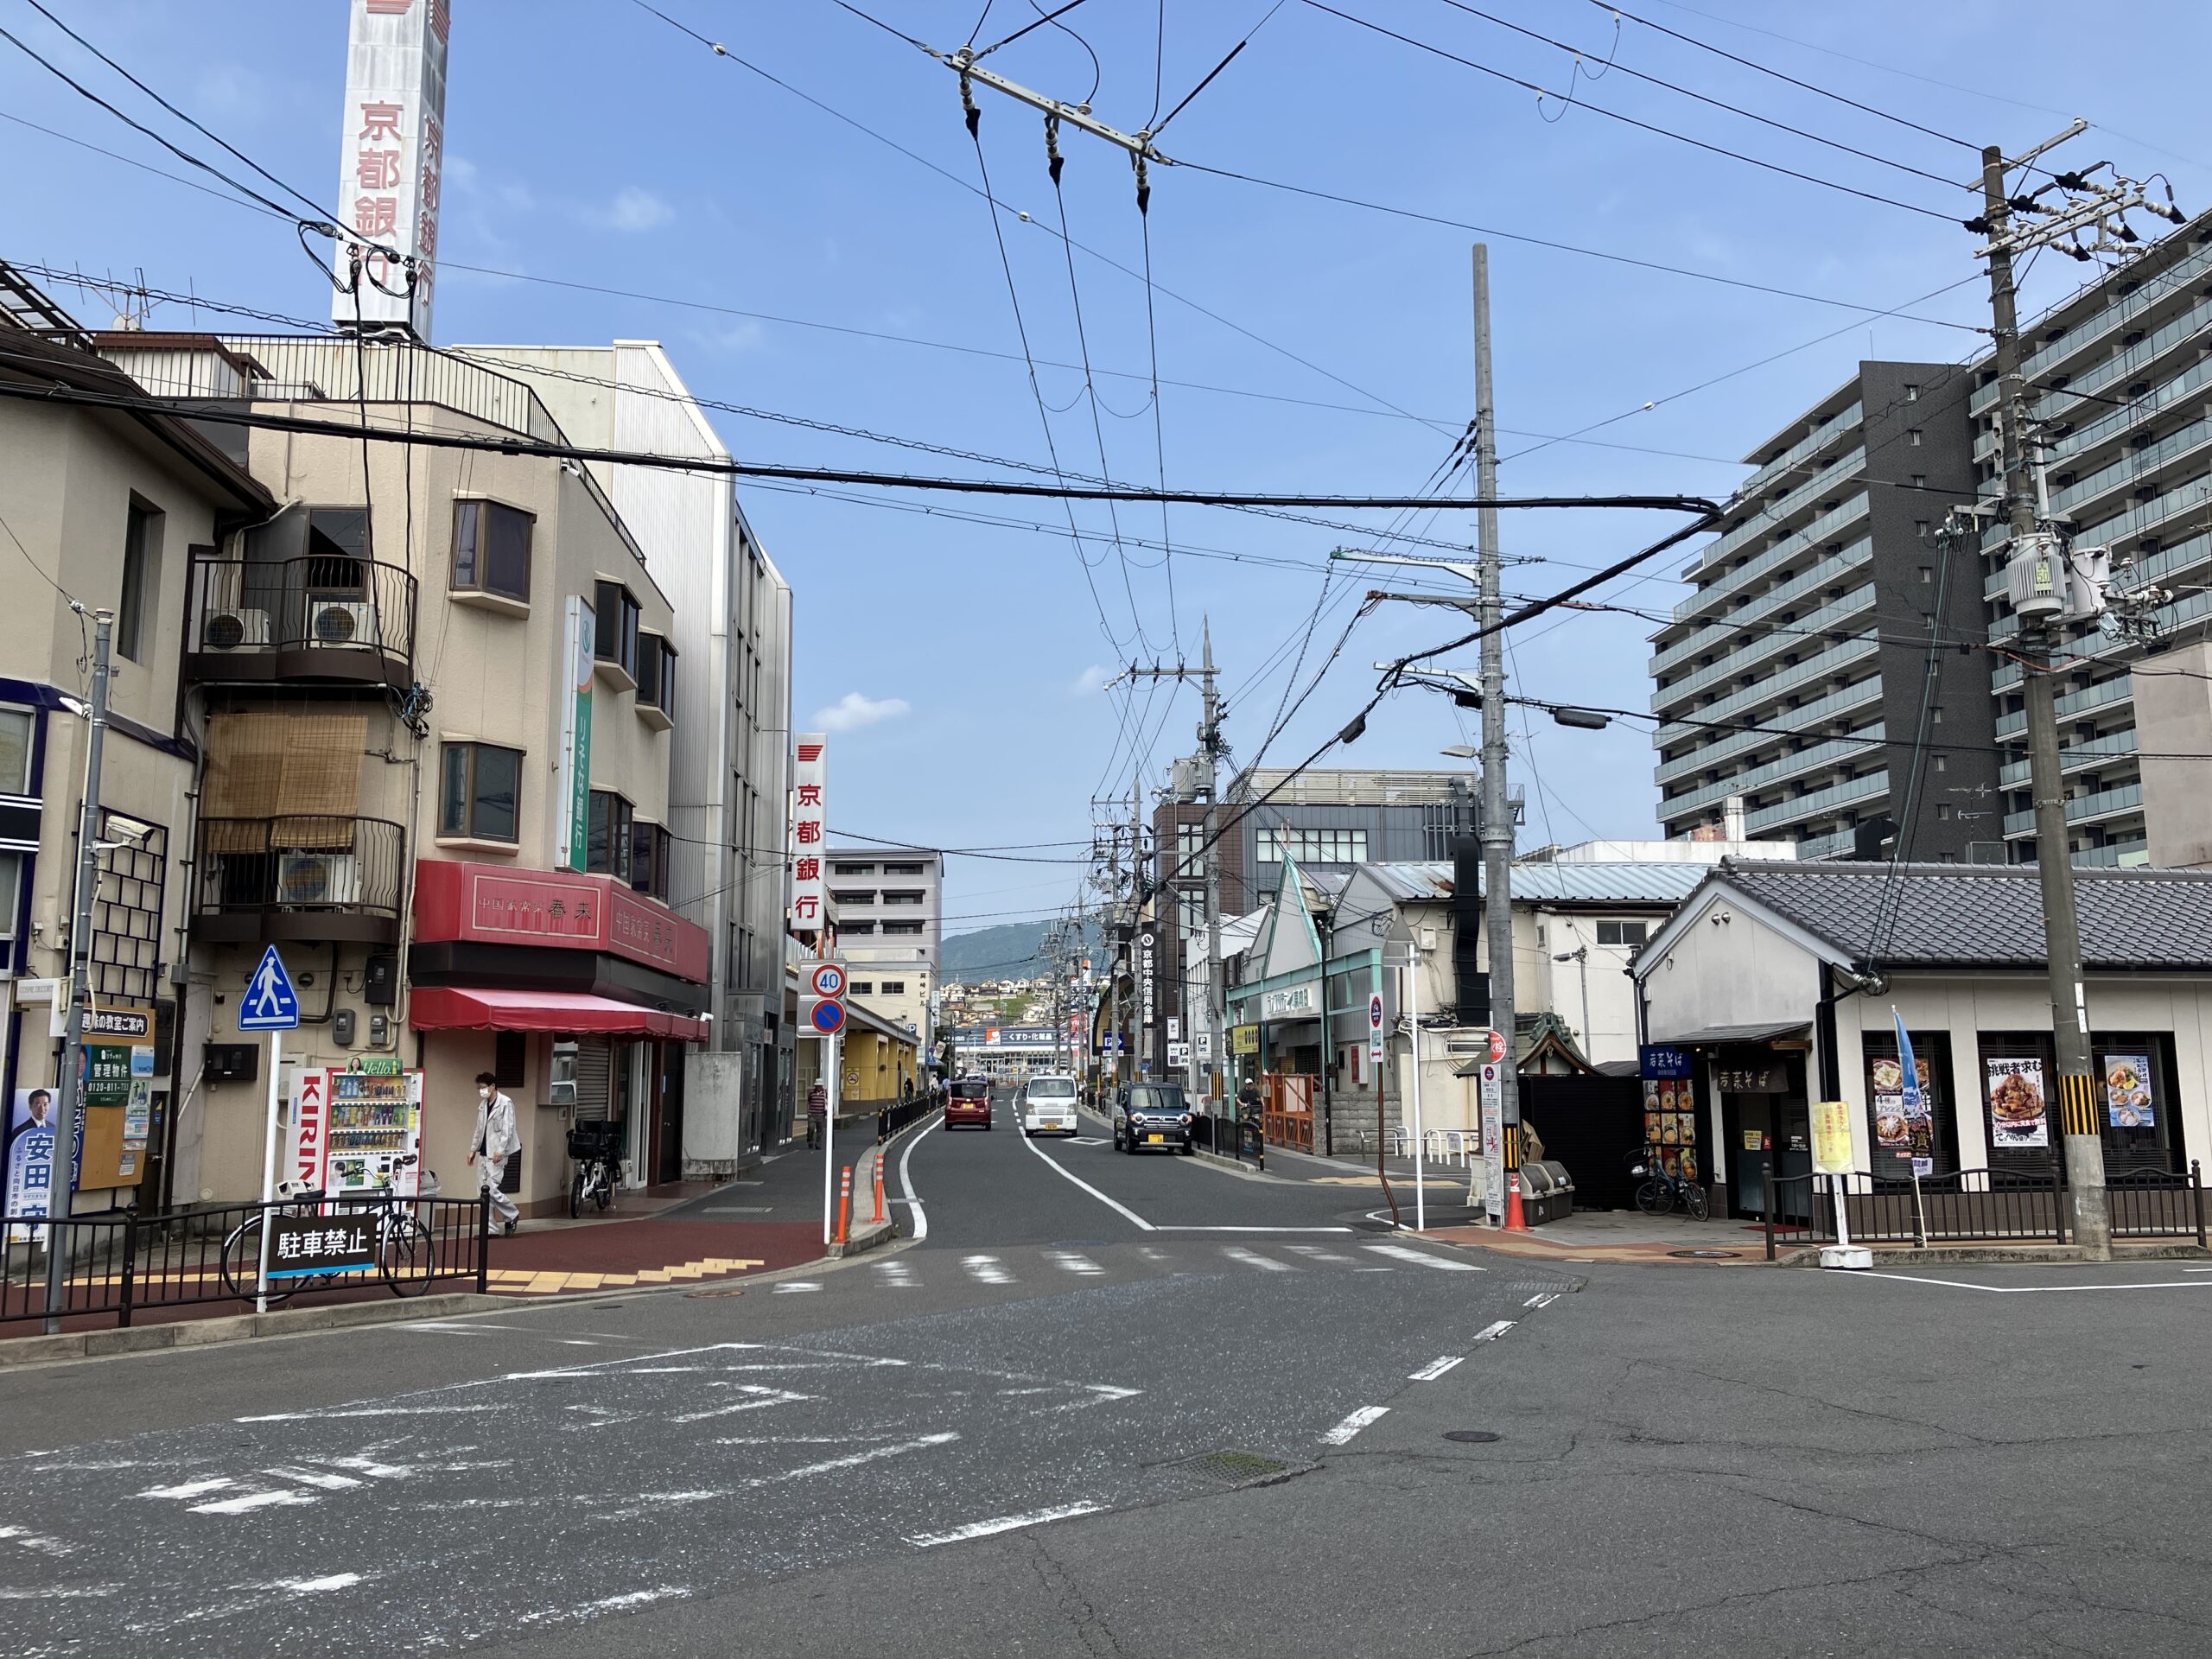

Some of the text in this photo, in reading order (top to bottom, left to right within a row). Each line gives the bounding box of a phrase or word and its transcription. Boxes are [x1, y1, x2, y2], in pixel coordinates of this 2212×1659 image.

[355, 100, 404, 287] 京都銀行
[416, 114, 441, 307] 京都銀行
[2037, 571, 2049, 582] 50
[575, 716, 585, 849] りそな銀行
[795, 784, 821, 918] 京都銀行
[819, 974, 838, 988] 40
[1142, 950, 1154, 1024] 京都中央信用金庫
[93, 1064, 128, 1078] 管理物件
[363, 1062, 391, 1075] Hello.
[1987, 1060, 2043, 1077] 挑戦者求む
[297, 1076, 321, 1187] KIRIN
[276, 1227, 368, 1259] 駐車禁止
